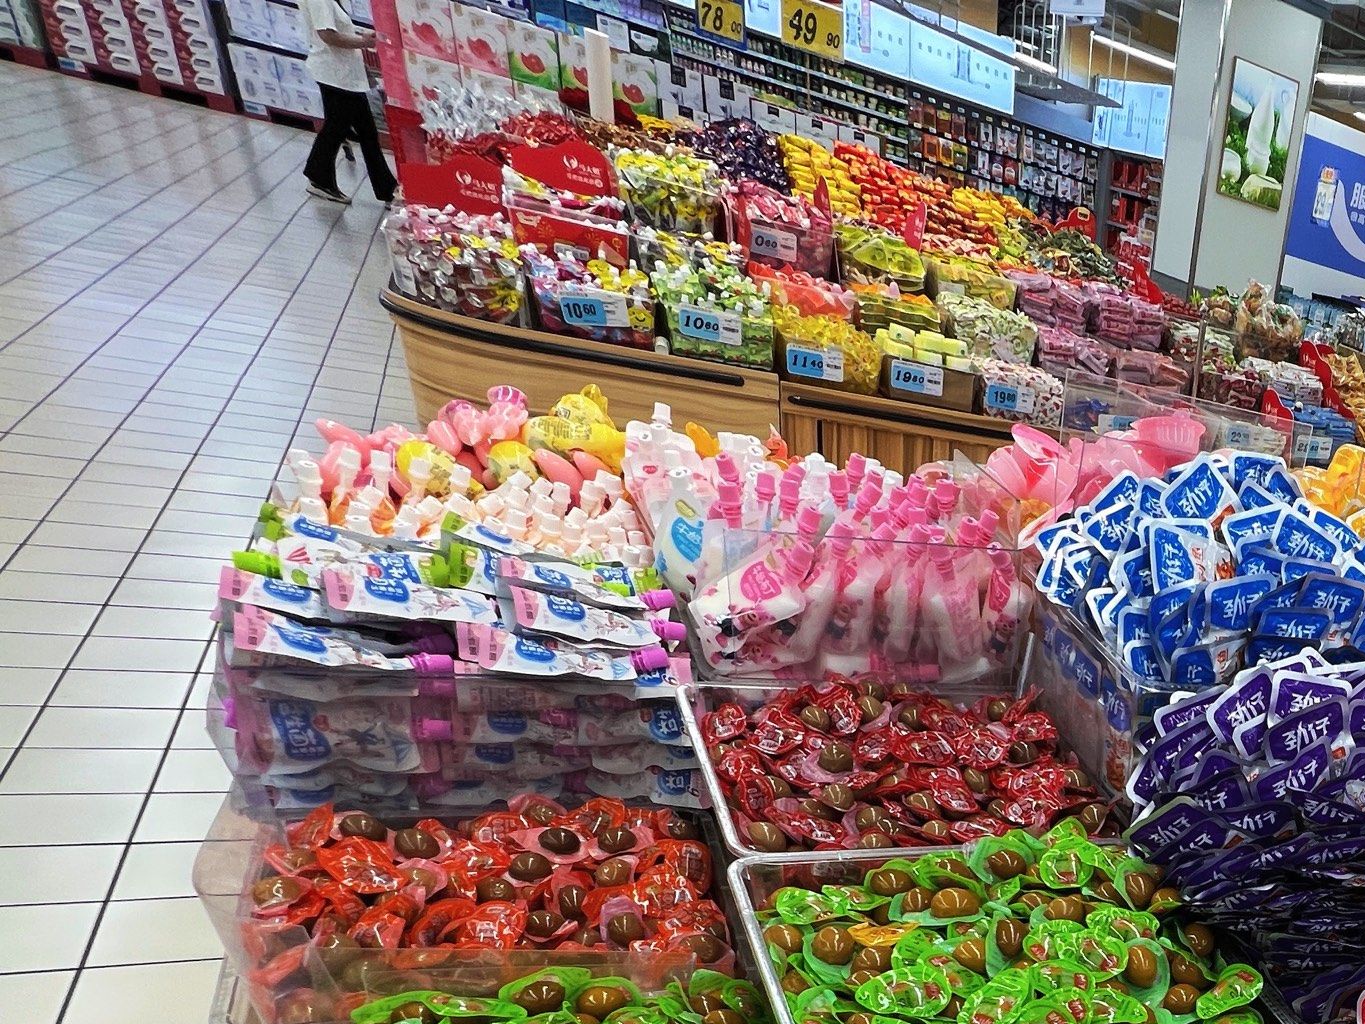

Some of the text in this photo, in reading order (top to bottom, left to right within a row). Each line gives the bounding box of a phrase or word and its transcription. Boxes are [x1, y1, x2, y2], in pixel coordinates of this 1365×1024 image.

[701, 3, 724, 31] 78
[789, 8, 818, 45] 49
[826, 32, 841, 49] 90
[1178, 481, 1214, 518] 劲仔
[1228, 686, 1267, 725] 劲仔
[1282, 716, 1332, 752] 劲仔
[1271, 759, 1319, 799] 劲仔
